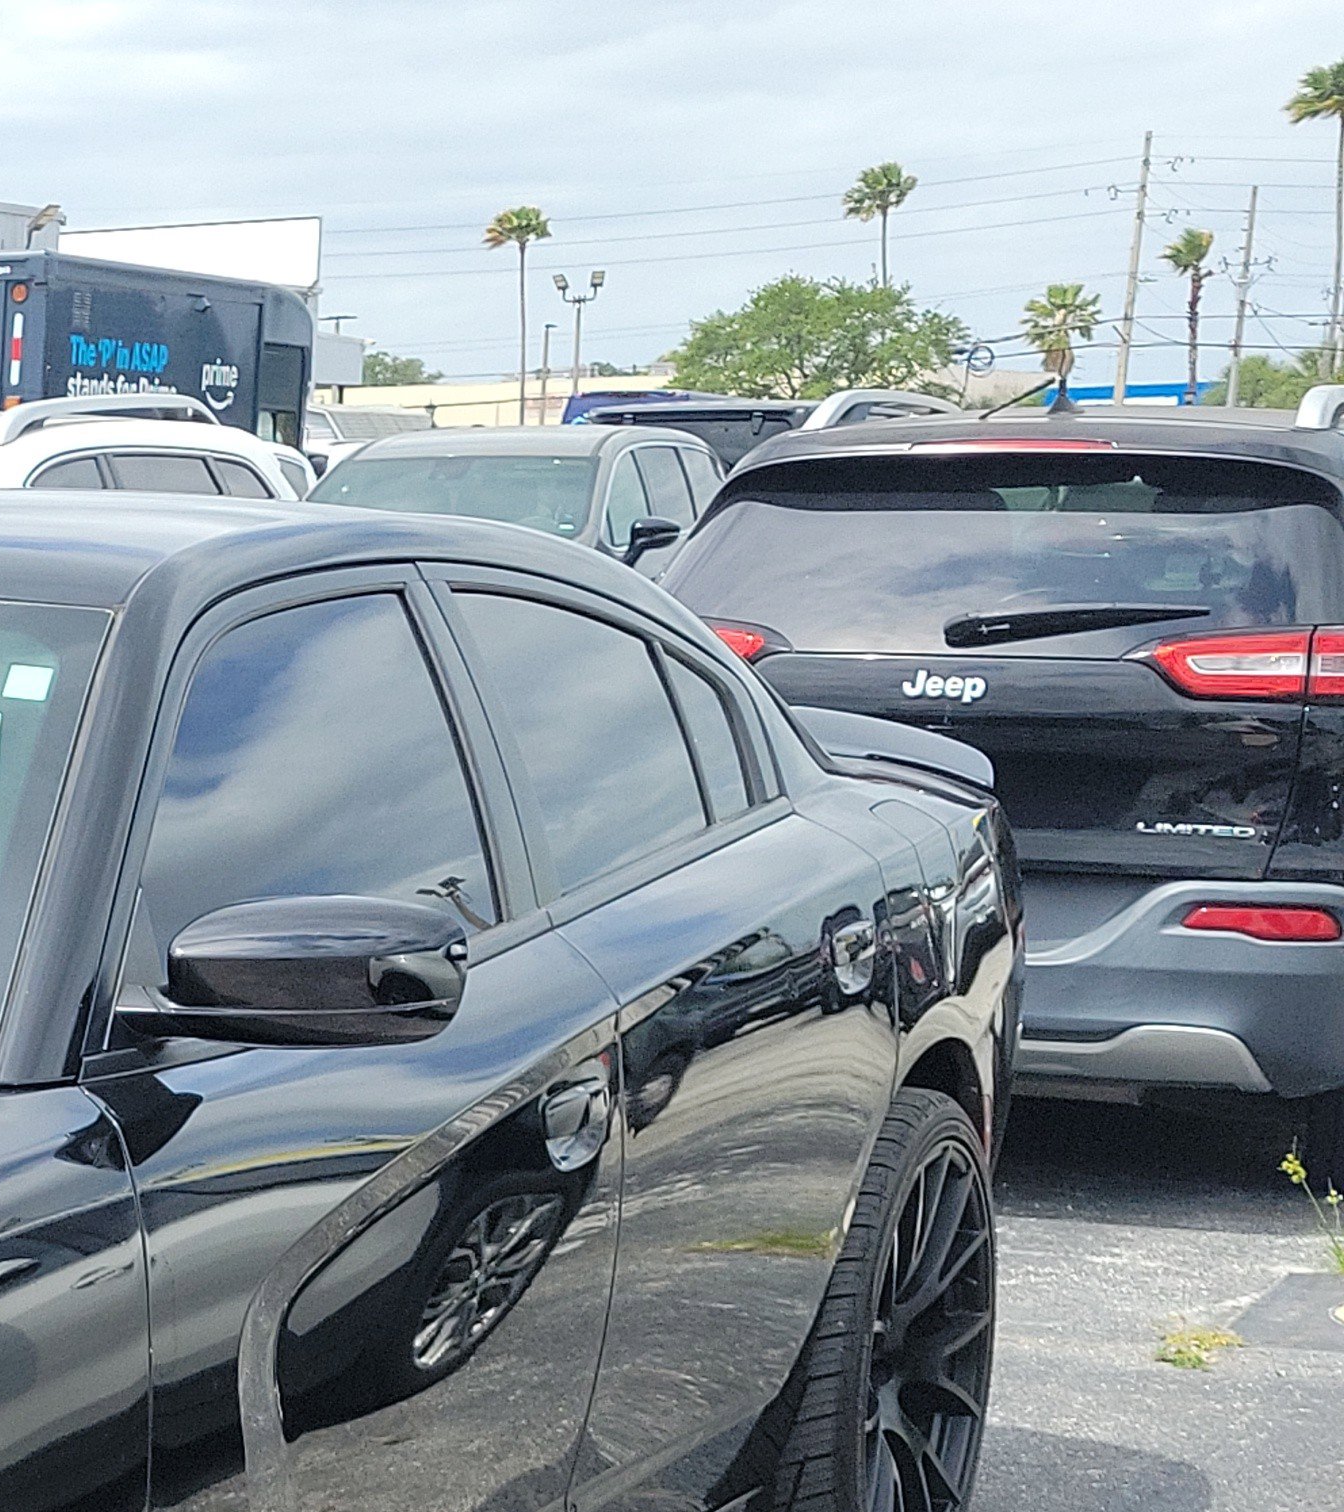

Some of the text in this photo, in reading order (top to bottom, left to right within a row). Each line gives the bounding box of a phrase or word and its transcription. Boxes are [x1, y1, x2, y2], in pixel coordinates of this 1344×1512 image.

[70, 334, 97, 367] The
[116, 340, 129, 370] in
[131, 341, 169, 373] ASAP
[67, 371, 115, 397] stands
[201, 357, 239, 391] prime
[902, 669, 986, 703] Jeep
[1136, 821, 1256, 838] LIMITED
